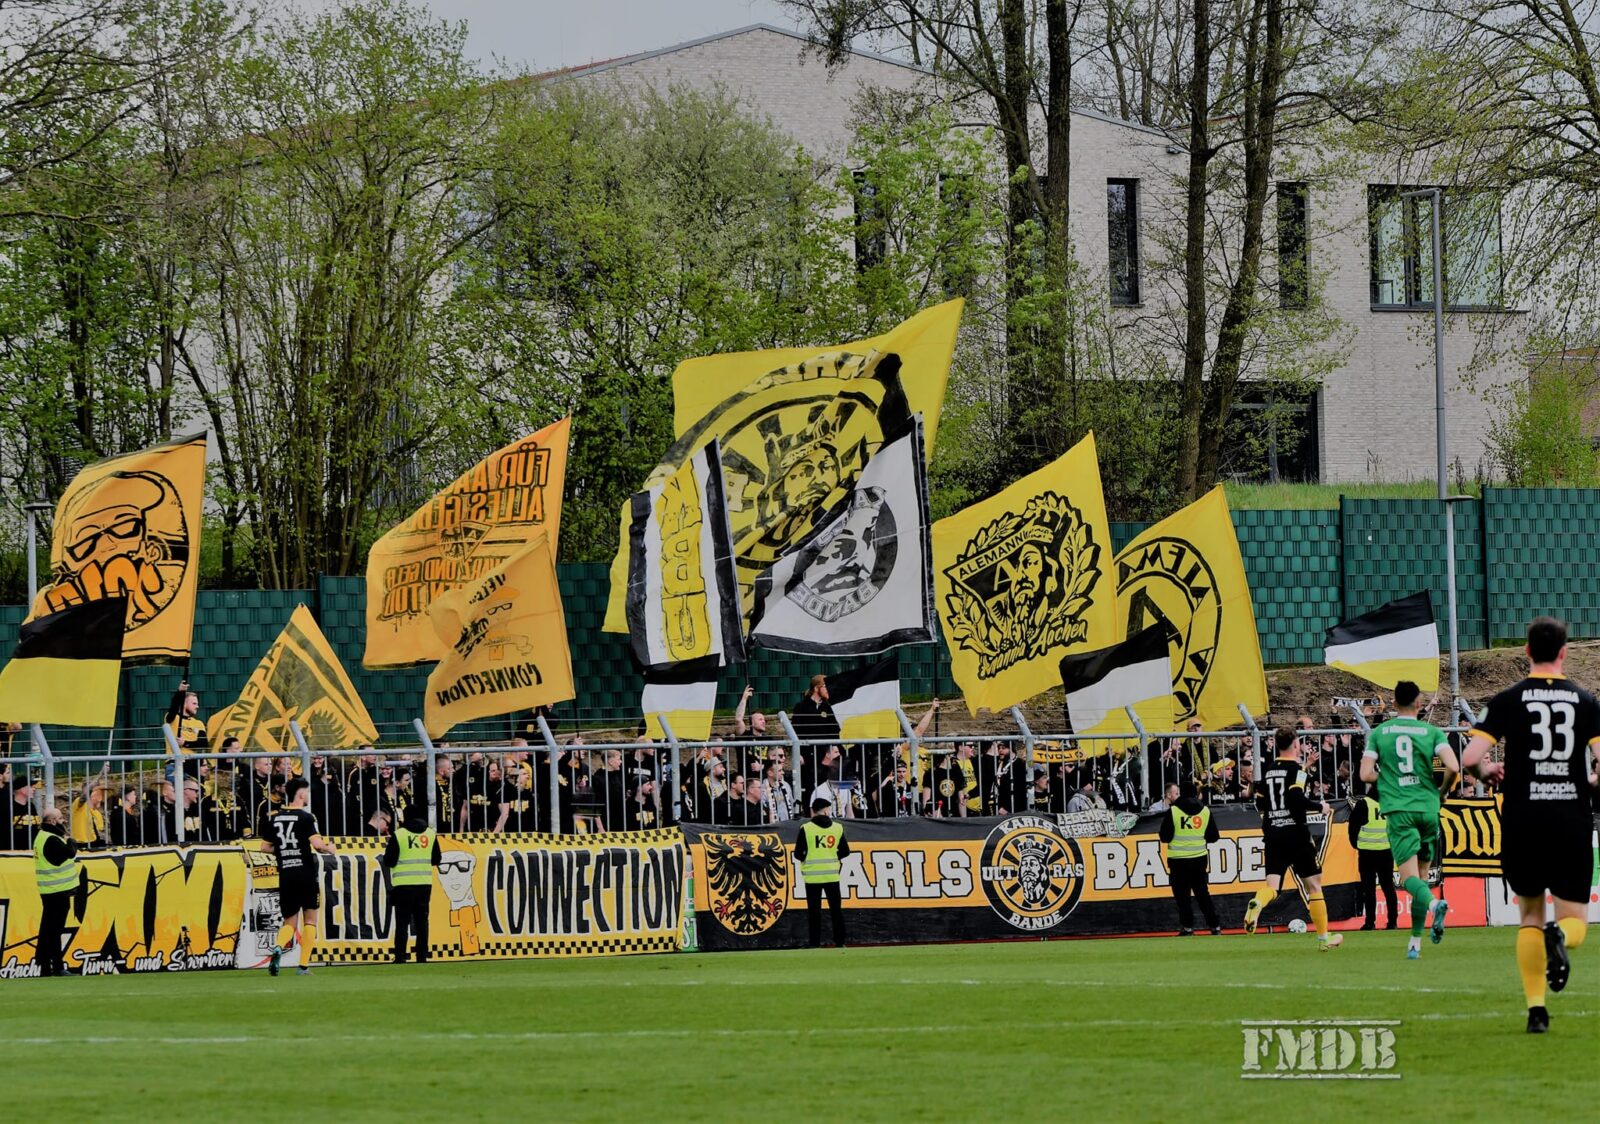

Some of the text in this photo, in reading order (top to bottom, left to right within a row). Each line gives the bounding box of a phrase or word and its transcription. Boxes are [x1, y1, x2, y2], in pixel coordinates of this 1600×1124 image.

[1027, 616, 1088, 661] Aachen
[1526, 702, 1576, 761] 33
[1395, 735, 1414, 774] 9
[1535, 762, 1570, 776] HEINZE
[1266, 777, 1286, 811] 17
[273, 821, 299, 850] 34
[999, 816, 1055, 835] KARLS
[1180, 815, 1203, 830] K9
[407, 836, 429, 849] K9
[814, 834, 836, 849] K9
[1092, 835, 1266, 891] BADE
[318, 853, 395, 940] ELLO
[486, 844, 683, 935] CONNECTION
[1009, 910, 1064, 930] BANDE
[136, 950, 163, 971] und
